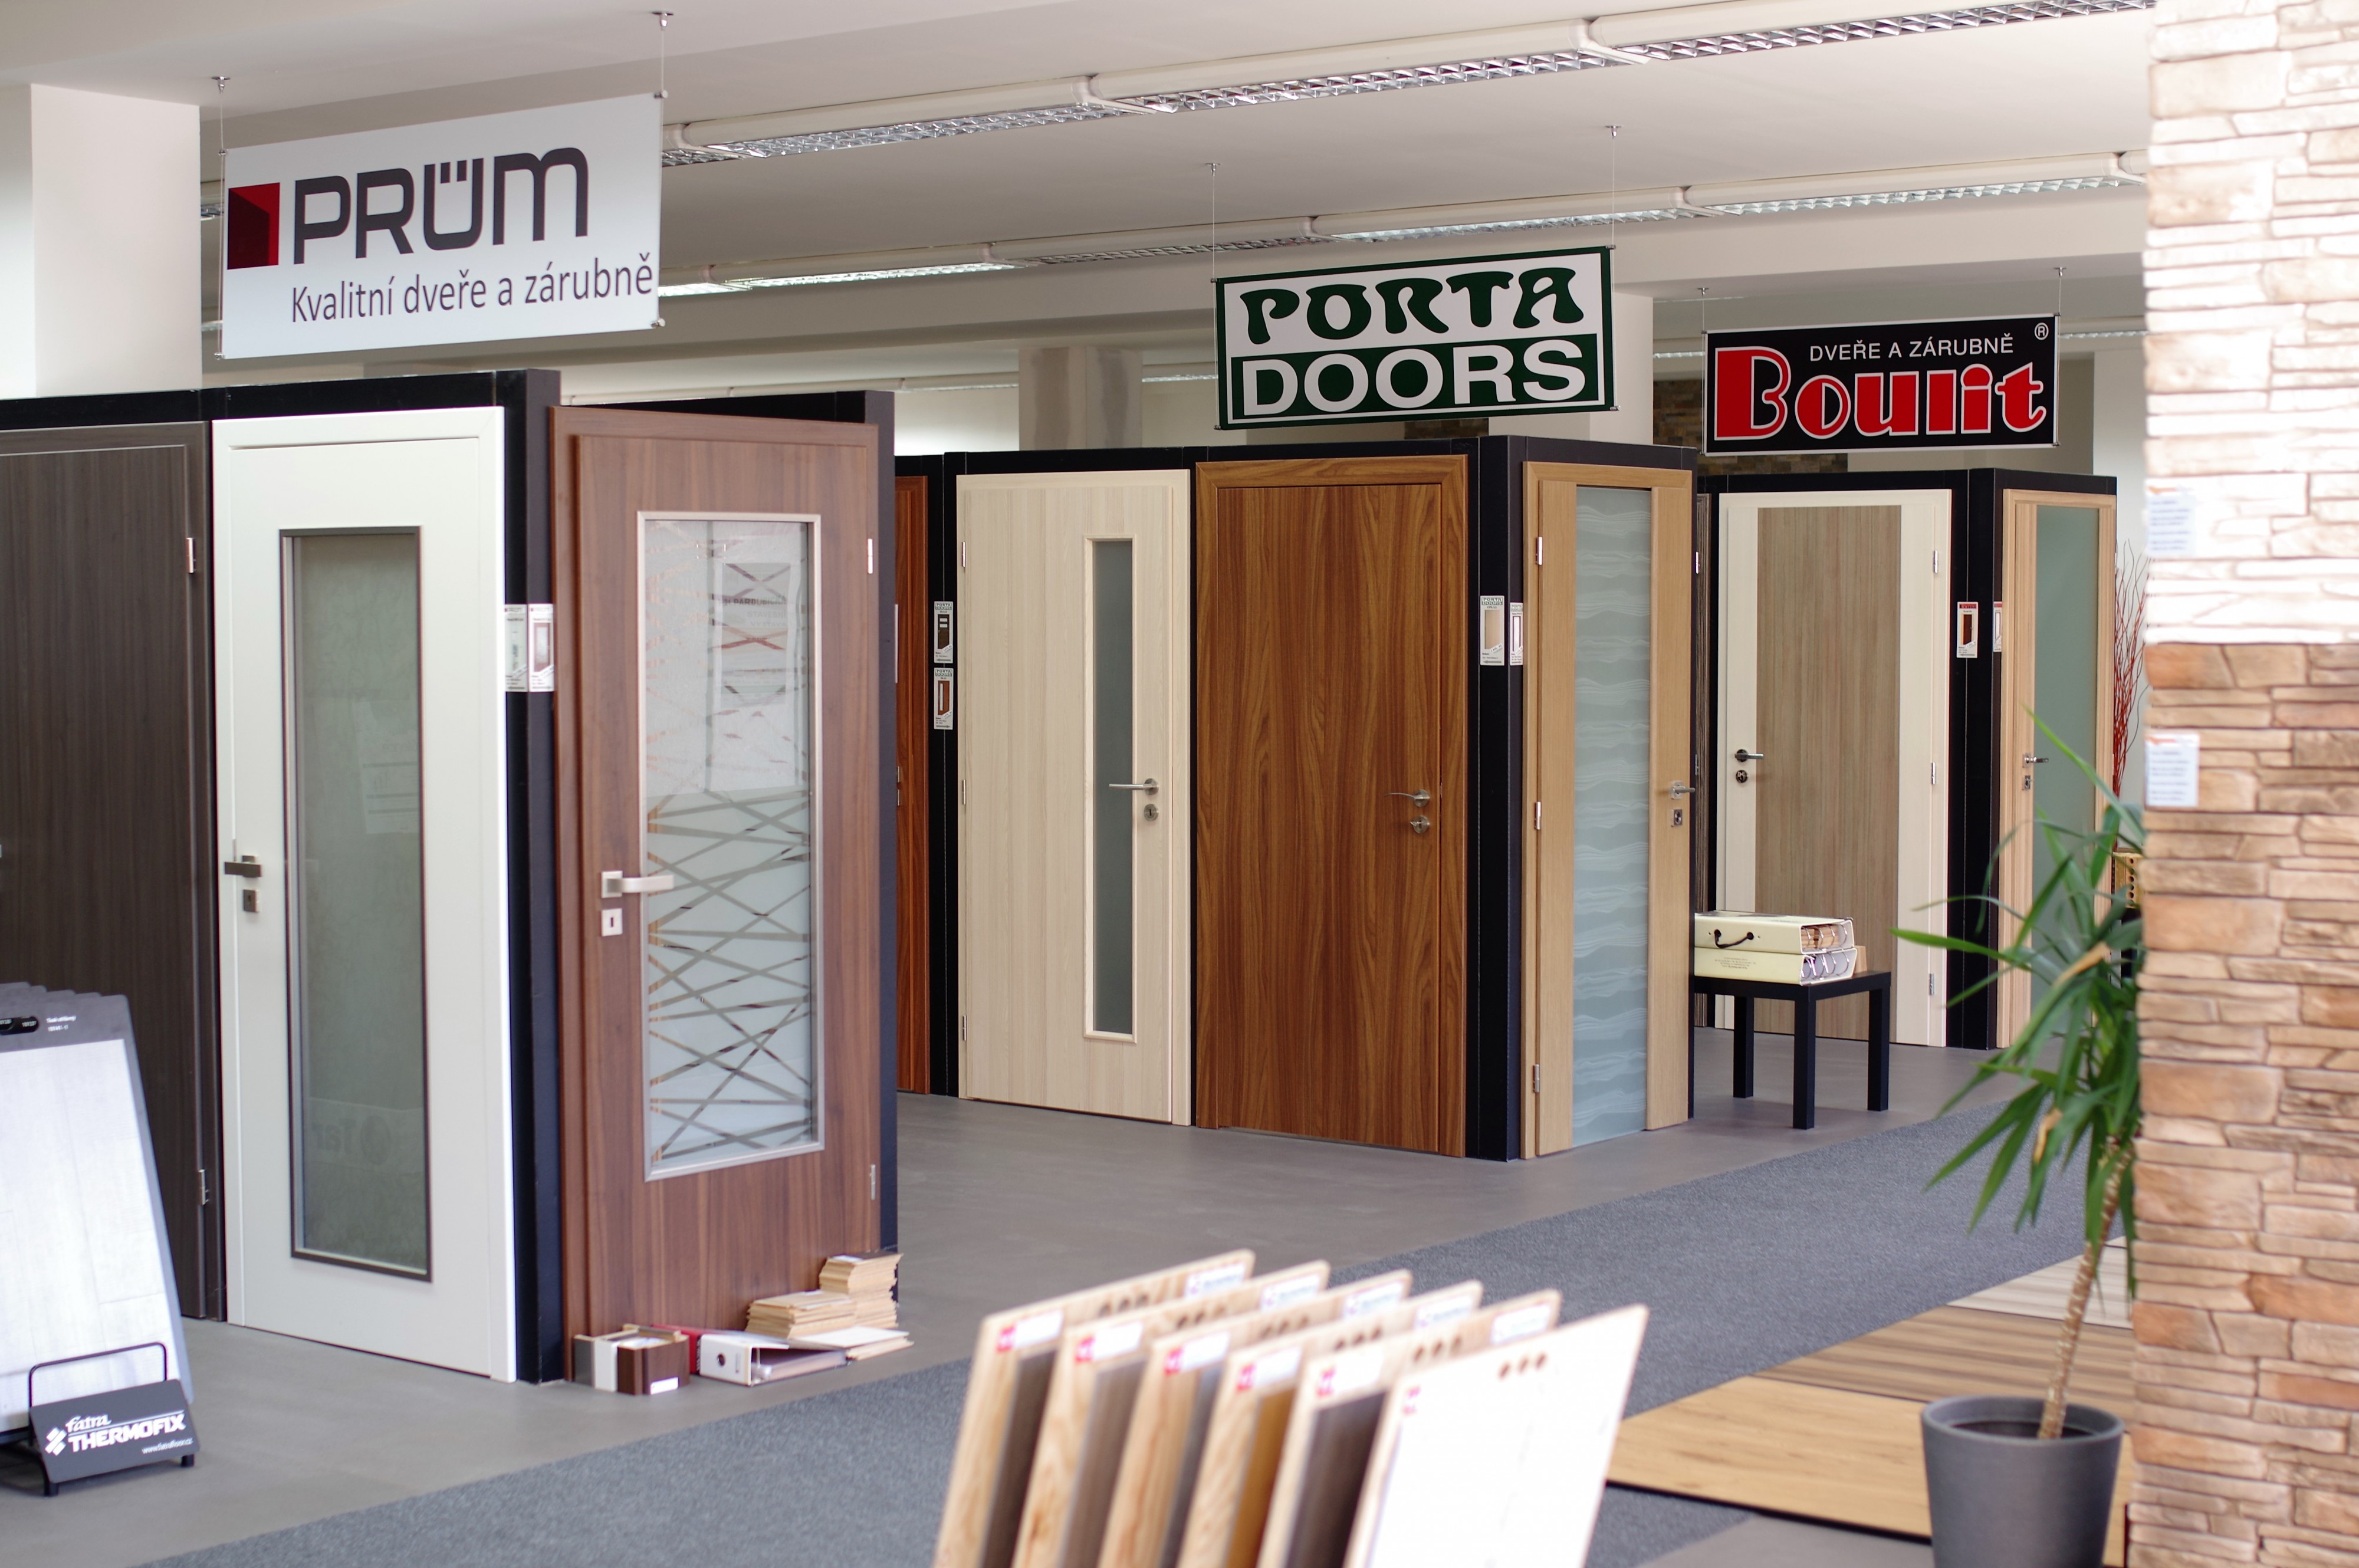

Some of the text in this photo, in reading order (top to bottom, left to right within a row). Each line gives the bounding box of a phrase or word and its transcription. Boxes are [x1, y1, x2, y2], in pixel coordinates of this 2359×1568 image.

[294, 147, 589, 265] PRÜM
[292, 252, 653, 323] Kvalitní dveře a zárubně
[1240, 267, 1585, 344] PORTA
[1242, 339, 1586, 416] DOORS
[1810, 333, 2013, 361] DVEŘE A ZÁRUBNĚ
[1714, 346, 2047, 441] Boulit
[65, 1413, 112, 1434] fatra
[68, 1413, 186, 1453] THERMOFIX
